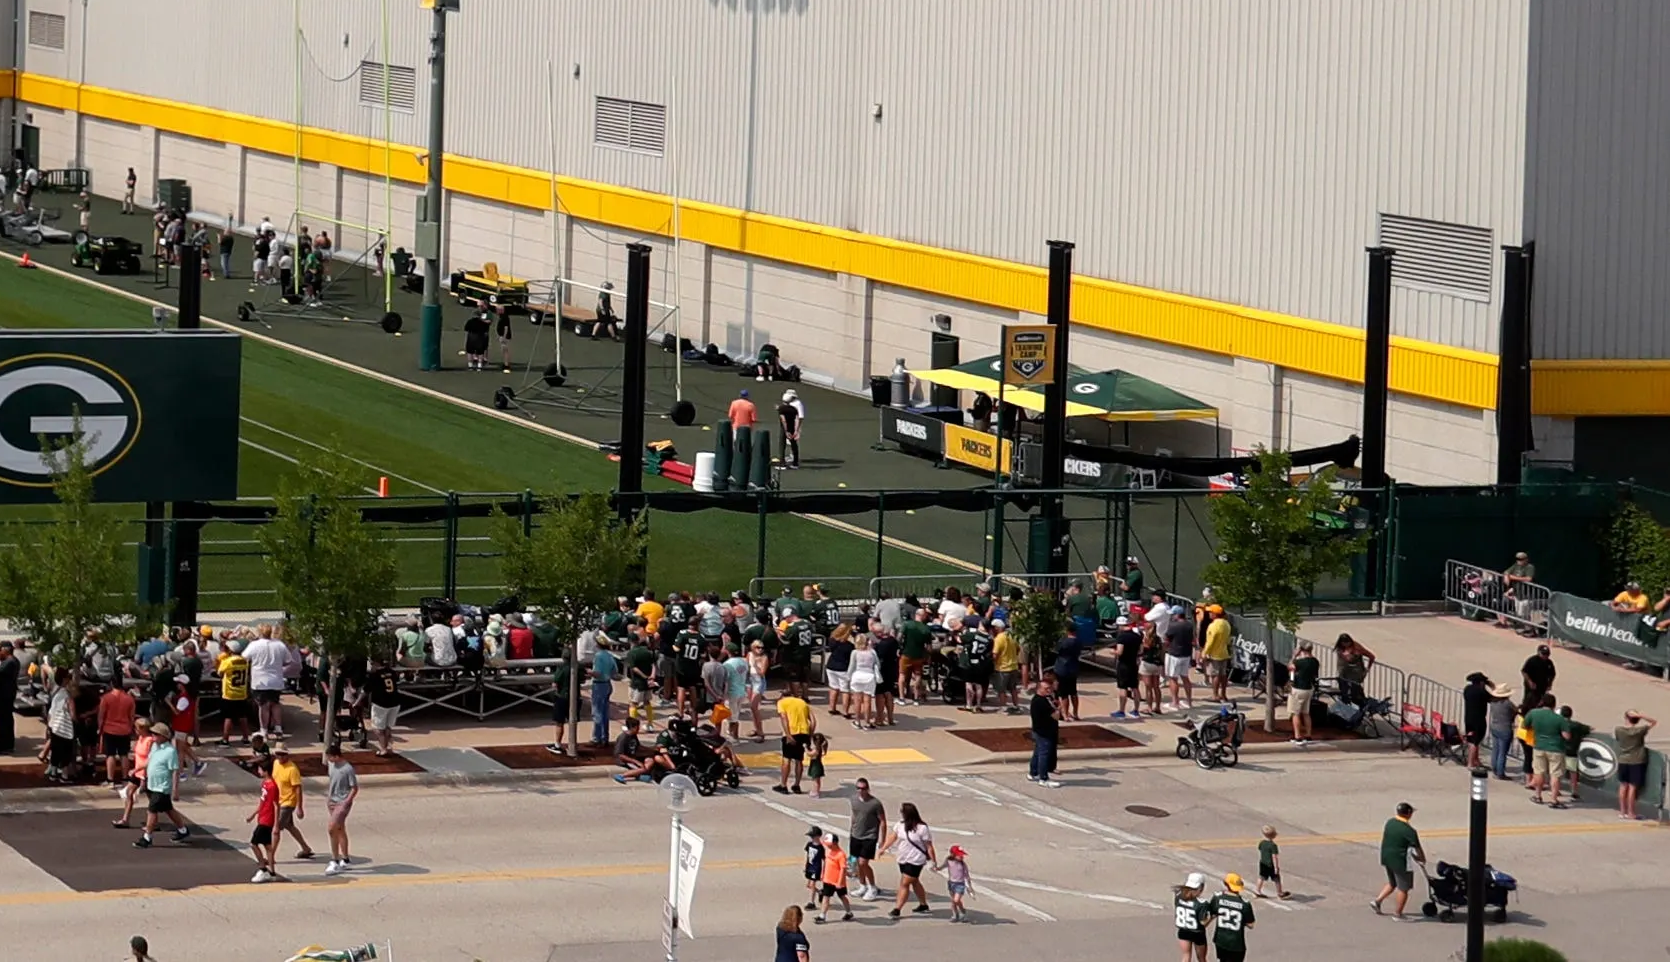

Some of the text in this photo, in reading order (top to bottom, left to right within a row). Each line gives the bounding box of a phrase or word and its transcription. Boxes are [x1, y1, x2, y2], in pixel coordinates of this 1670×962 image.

[896, 418, 927, 440] PACKERS
[961, 437, 993, 459] PACKERS
[1064, 458, 1101, 477] CKERS
[1565, 611, 1643, 646] bellinhea
[683, 643, 699, 660] 10
[231, 670, 246, 686] 21
[384, 680, 394, 693] 9
[1578, 741, 1614, 776] G
[1175, 906, 1197, 929] 85
[1218, 908, 1242, 931] 23
